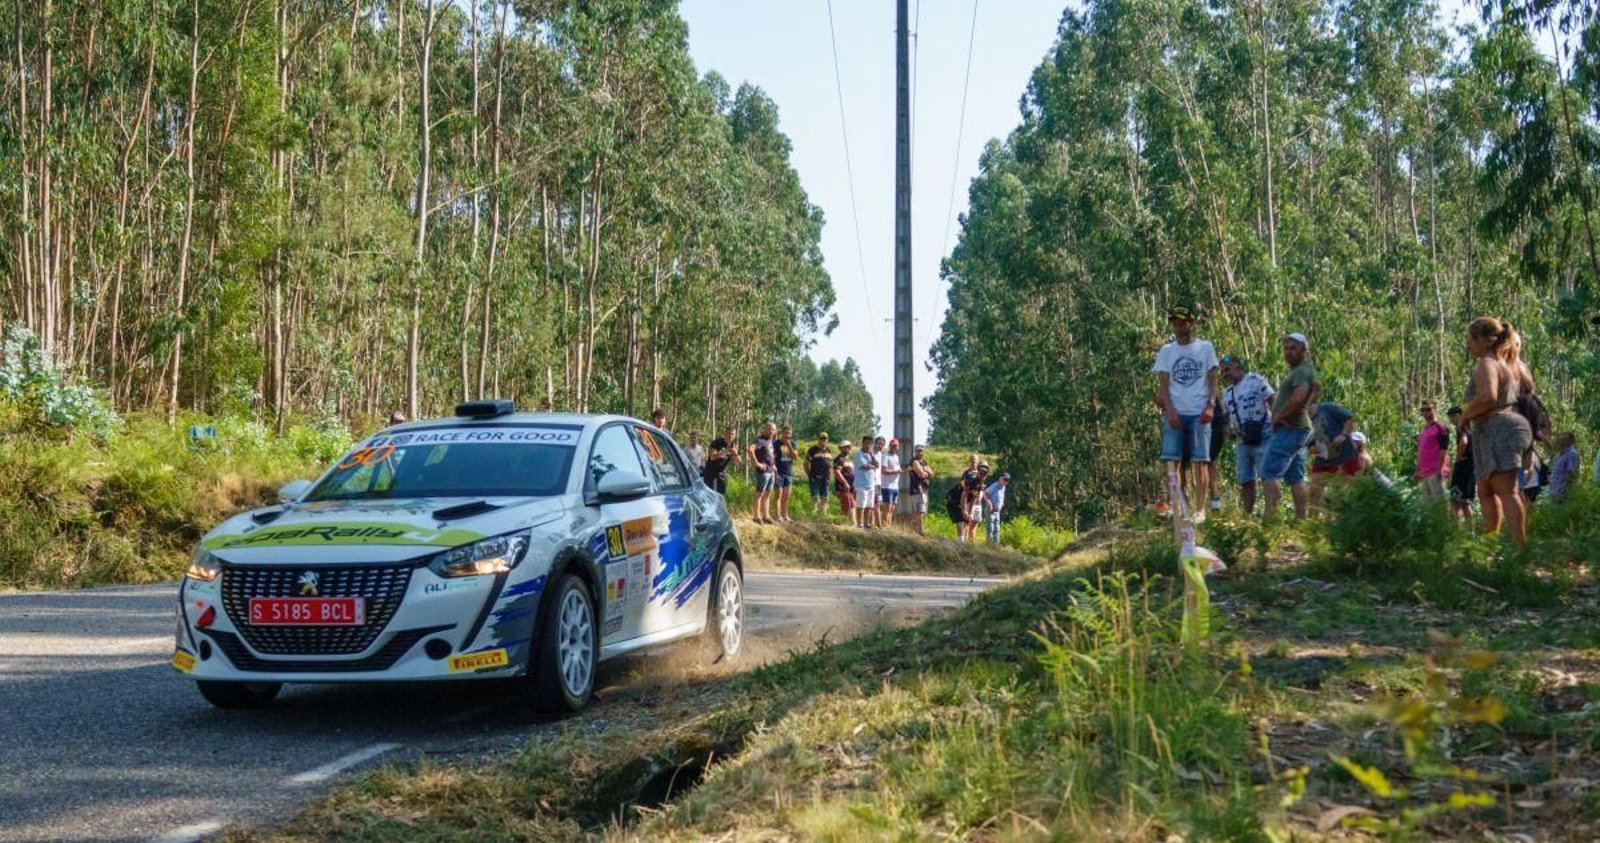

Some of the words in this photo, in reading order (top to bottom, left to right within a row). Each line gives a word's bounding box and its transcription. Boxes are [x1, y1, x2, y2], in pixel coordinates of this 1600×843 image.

[415, 431, 461, 443] RACE
[465, 431, 504, 442] FOR
[509, 430, 572, 442] GOOD
[608, 526, 622, 556] 30
[253, 603, 263, 620] S
[272, 603, 311, 620] 5185
[321, 603, 352, 620] BCL
[453, 651, 502, 670] PIRELLI
